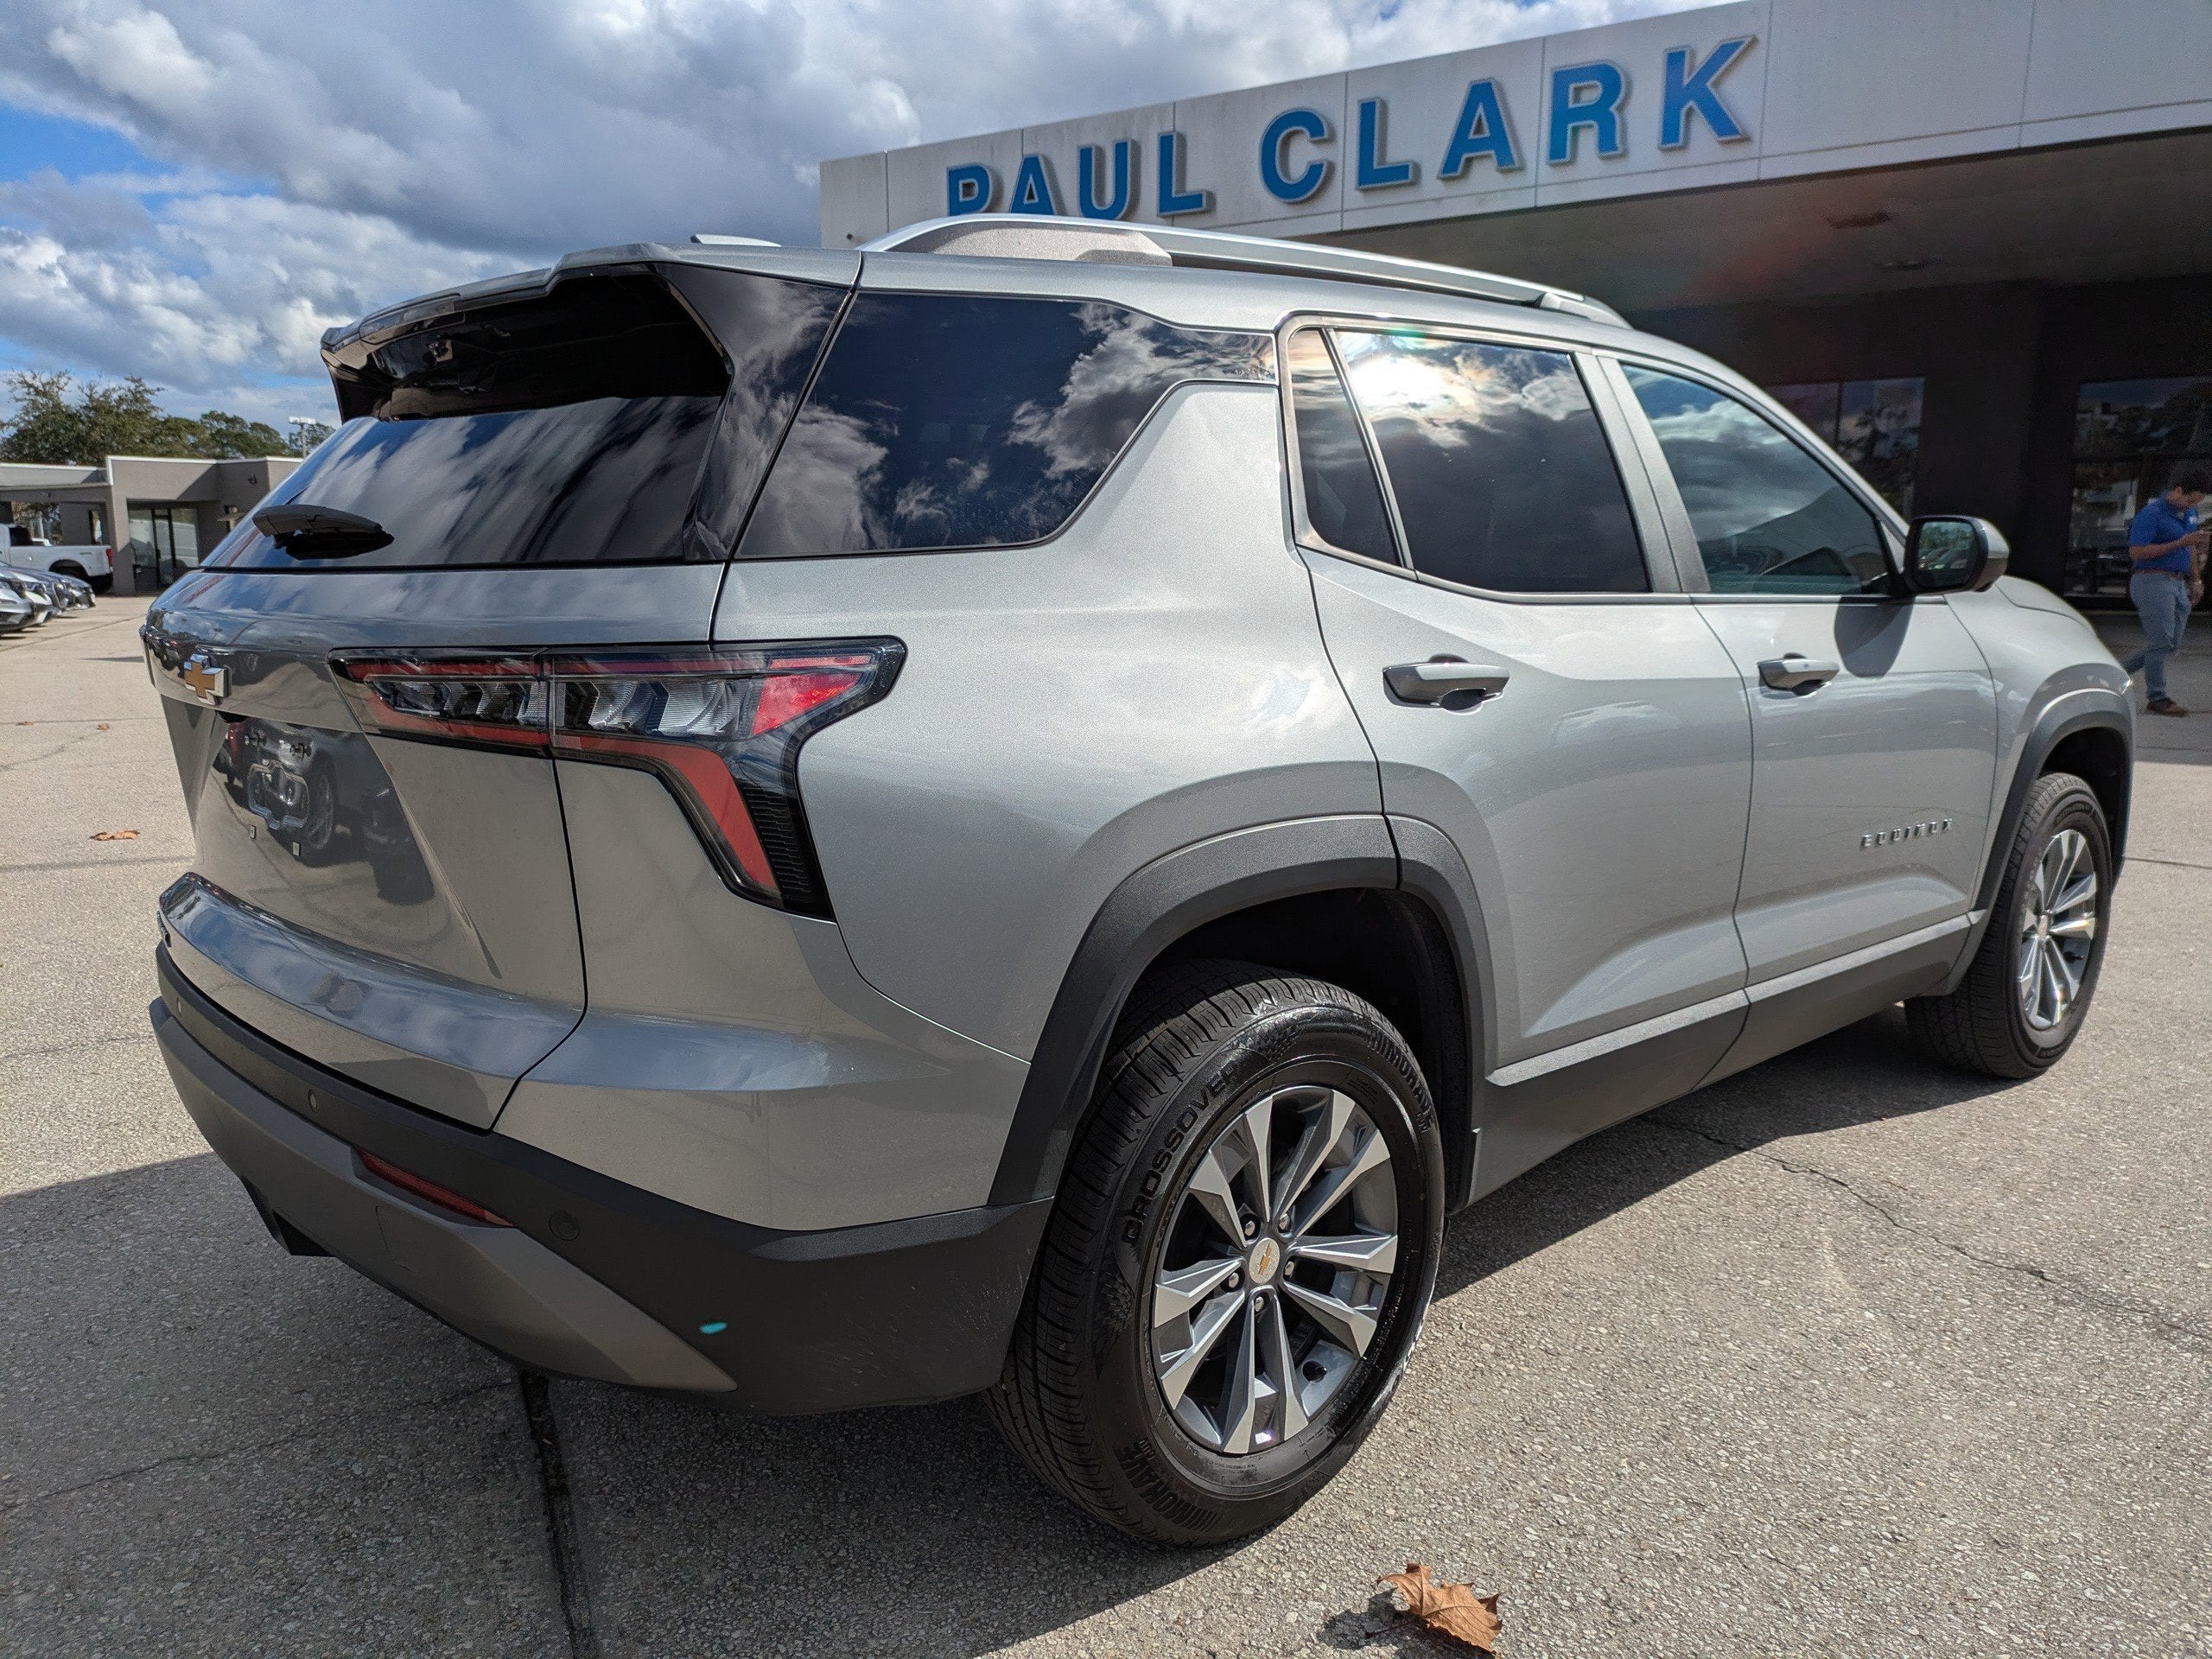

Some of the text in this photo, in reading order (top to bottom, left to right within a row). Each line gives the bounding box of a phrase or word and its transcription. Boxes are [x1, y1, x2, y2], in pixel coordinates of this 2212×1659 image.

[947, 35, 1756, 219] PAUL CLARK
[1122, 1061, 1238, 1245] CROSSOVER
